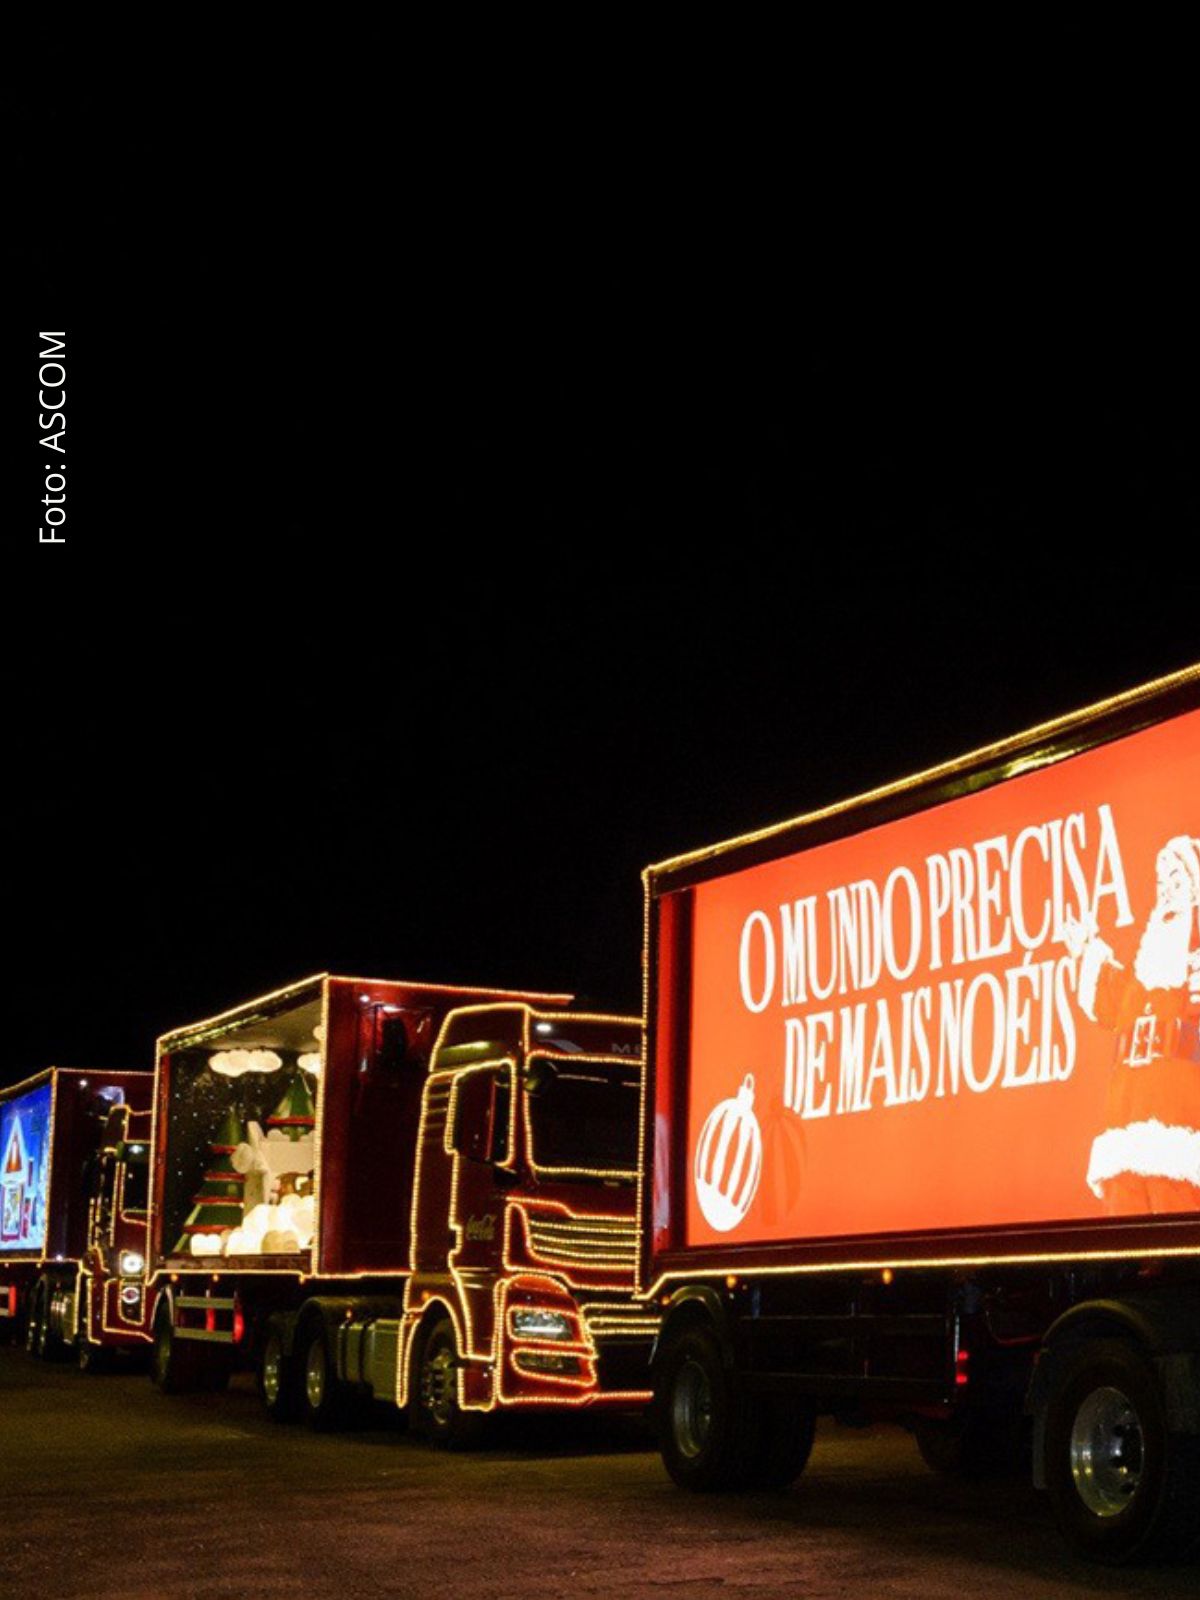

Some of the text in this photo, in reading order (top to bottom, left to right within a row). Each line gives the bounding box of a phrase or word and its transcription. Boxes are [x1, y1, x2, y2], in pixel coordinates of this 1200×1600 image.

[739, 804, 1135, 1013] O MUNDO PRECISA
[784, 951, 1076, 1120] DE MAIS NOÉIS
